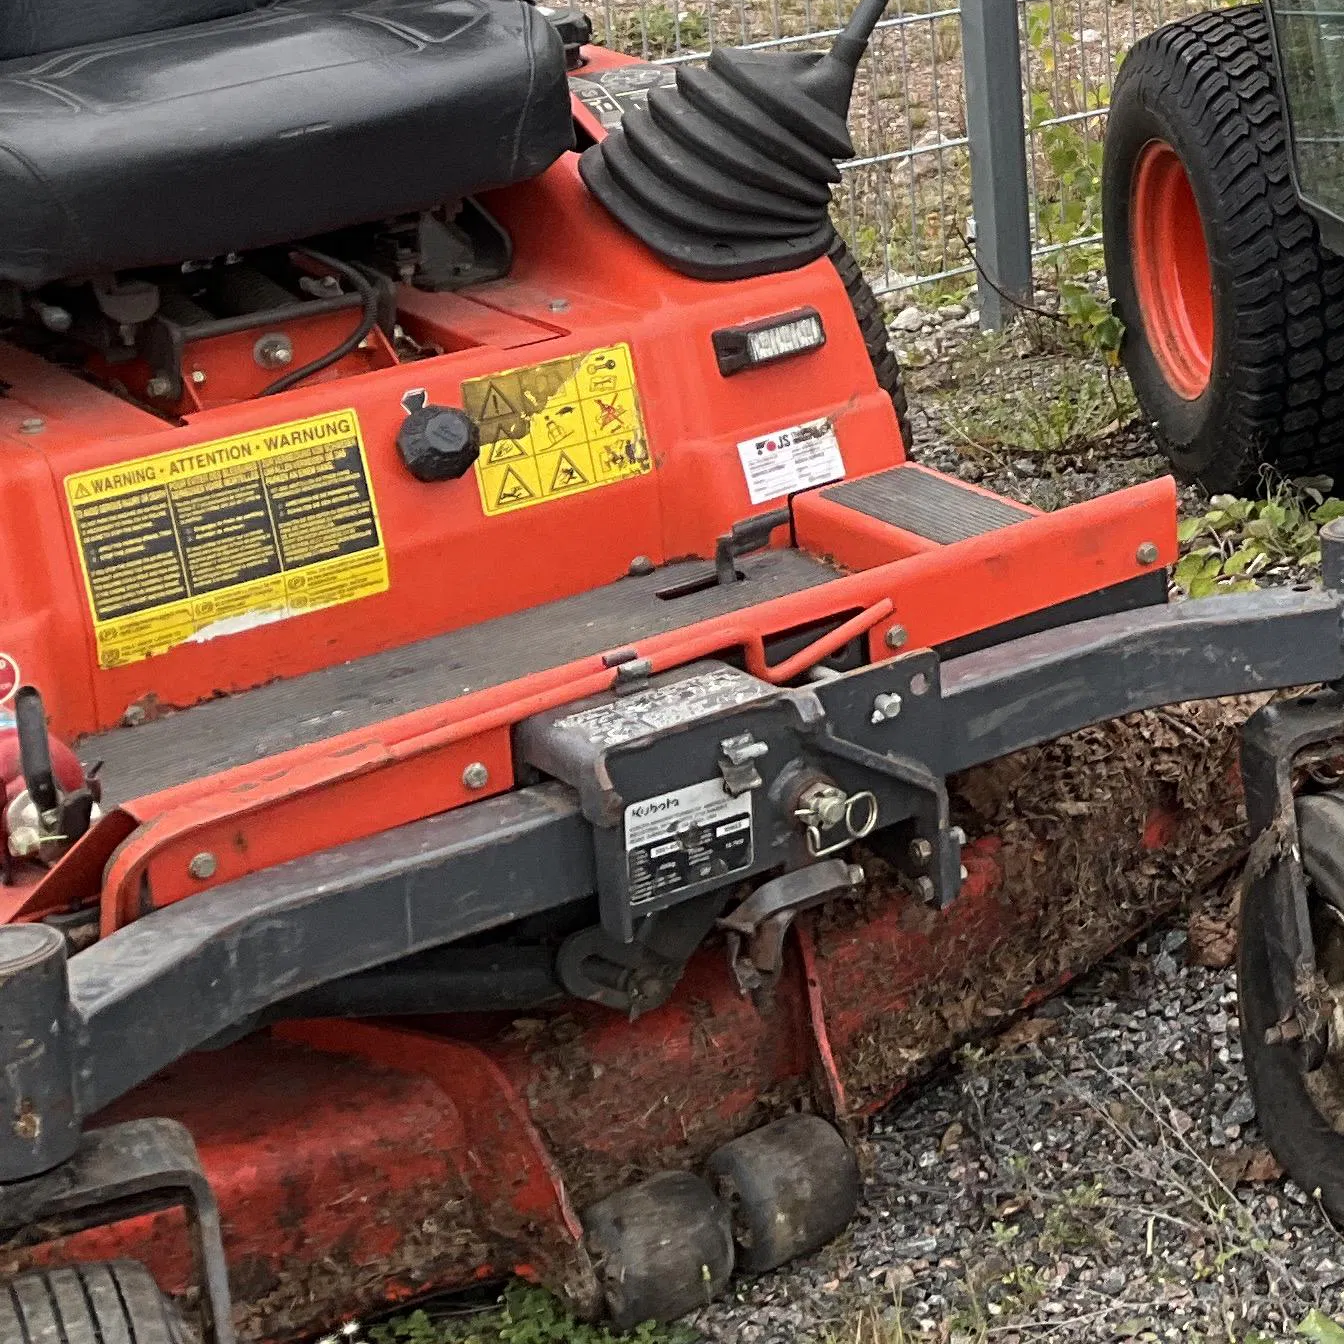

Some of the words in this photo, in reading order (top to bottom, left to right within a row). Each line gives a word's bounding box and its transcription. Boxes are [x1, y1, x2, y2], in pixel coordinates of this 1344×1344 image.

[777, 434, 791, 450] JS
[90, 466, 156, 494] WARNING
[169, 442, 252, 475] ATTENTION
[263, 419, 351, 452] WARNUNG
[631, 797, 680, 818] Kubota
